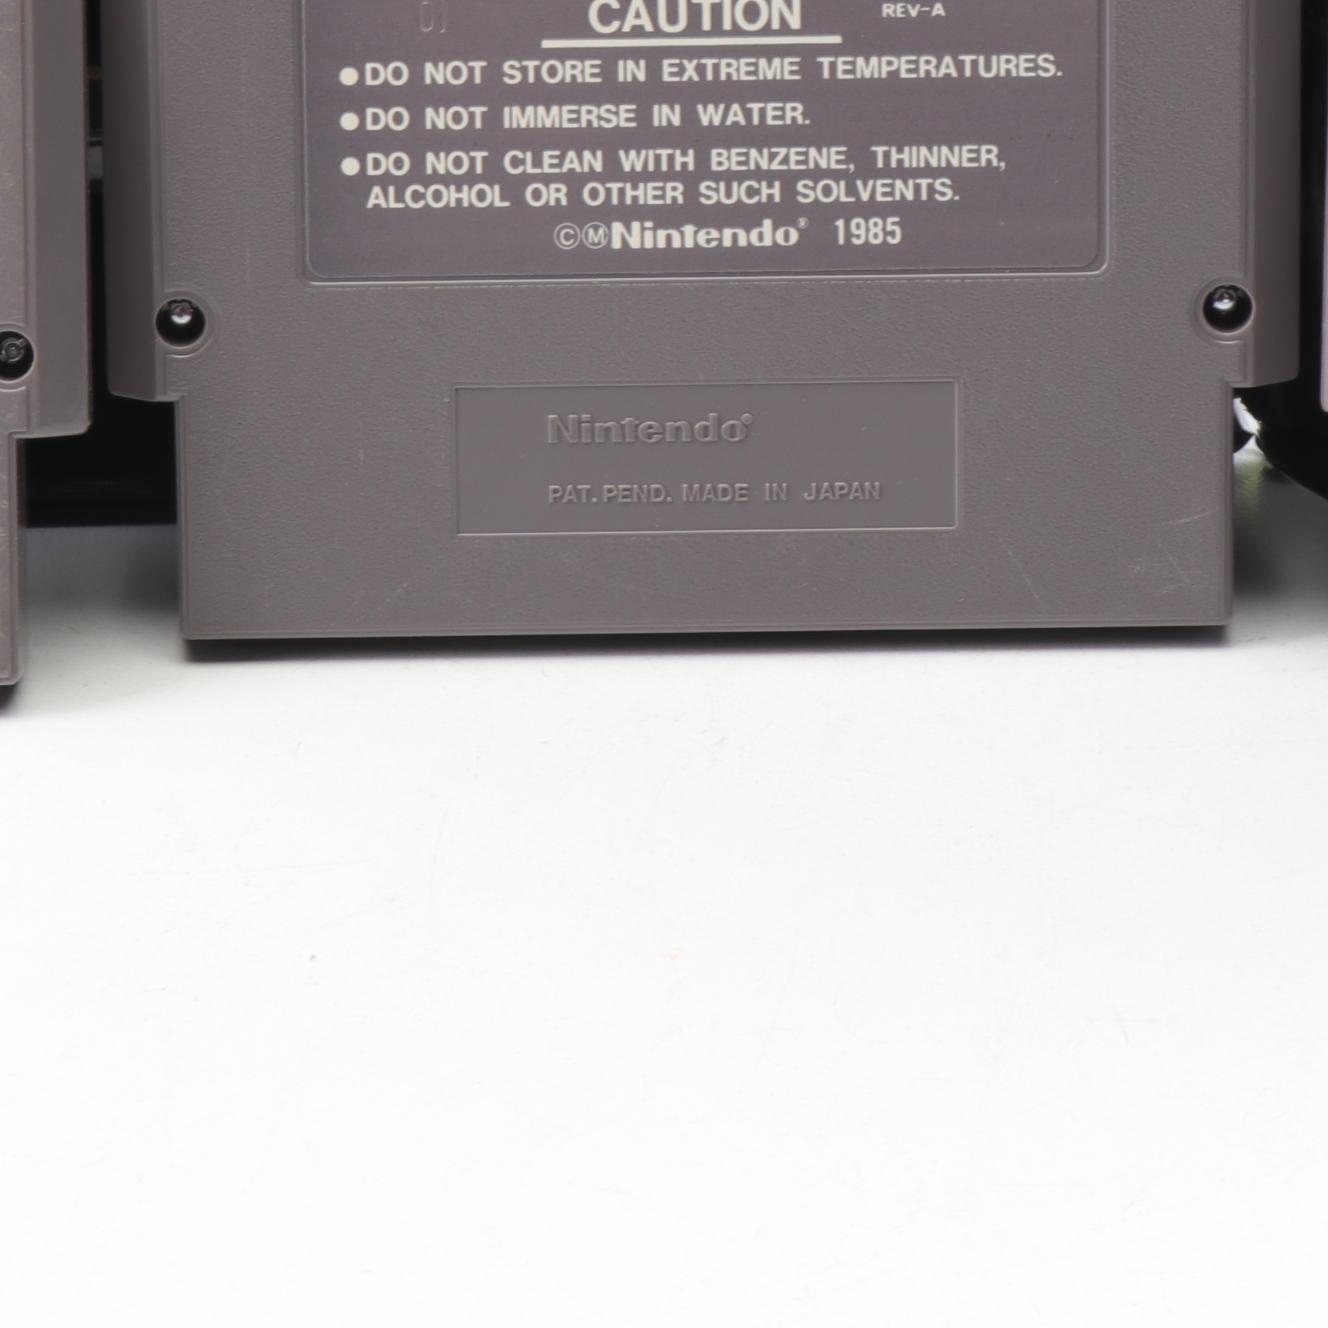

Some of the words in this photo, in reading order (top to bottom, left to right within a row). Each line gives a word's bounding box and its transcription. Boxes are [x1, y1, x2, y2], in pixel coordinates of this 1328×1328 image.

[881, 2, 946, 18] REV-A
[364, 61, 410, 86] DO
[424, 60, 488, 86] NOT
[502, 59, 603, 85] STORE
[617, 59, 646, 83] IN
[661, 56, 802, 82] EXTREME
[816, 53, 1063, 80] TEMPERATURES.
[365, 106, 410, 132] DO
[424, 105, 489, 131] NOT
[503, 103, 638, 129] IMMERSE
[652, 103, 681, 127] IN
[696, 102, 811, 127] WATER.
[366, 151, 411, 176] DO
[425, 150, 489, 176] NOT
[503, 149, 603, 175] CLEAN
[618, 148, 695, 173] WITH
[710, 146, 855, 173] BENZENE,
[870, 144, 1006, 171] THINNER,
[366, 183, 511, 209] ALCOHOL
[524, 182, 568, 208] OR
[582, 181, 685, 207] OTHER
[698, 180, 781, 205] SUCH
[796, 177, 960, 204] SOLVENTS.
[834, 216, 902, 245] 1985
[681, 482, 749, 503] MADE
[764, 482, 787, 501] IN
[803, 480, 881, 501] JAPAN
